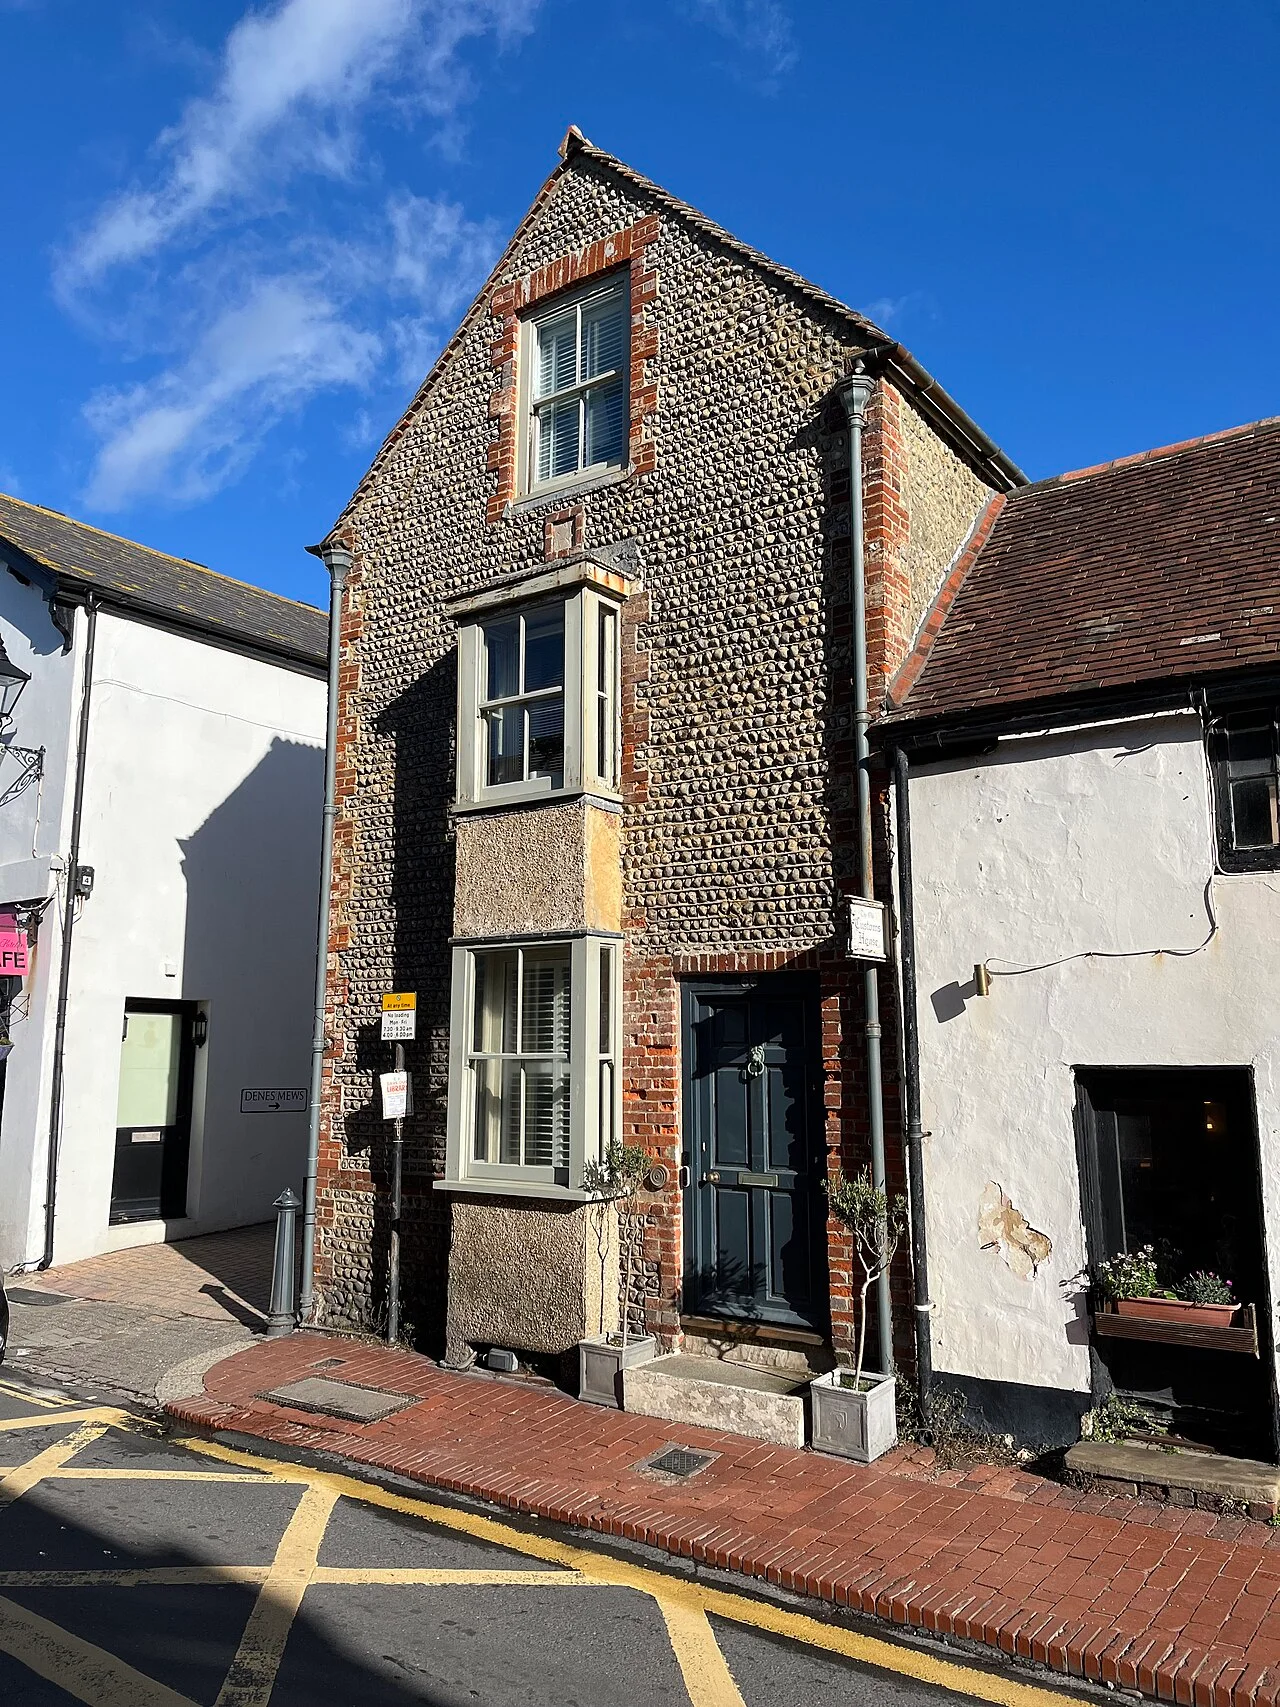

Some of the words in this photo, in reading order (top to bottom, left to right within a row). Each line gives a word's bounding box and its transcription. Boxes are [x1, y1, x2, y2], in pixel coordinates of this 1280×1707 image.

[0, 951, 26, 968] FE
[245, 1091, 275, 1101] DENES
[278, 1090, 304, 1101] MEWS
